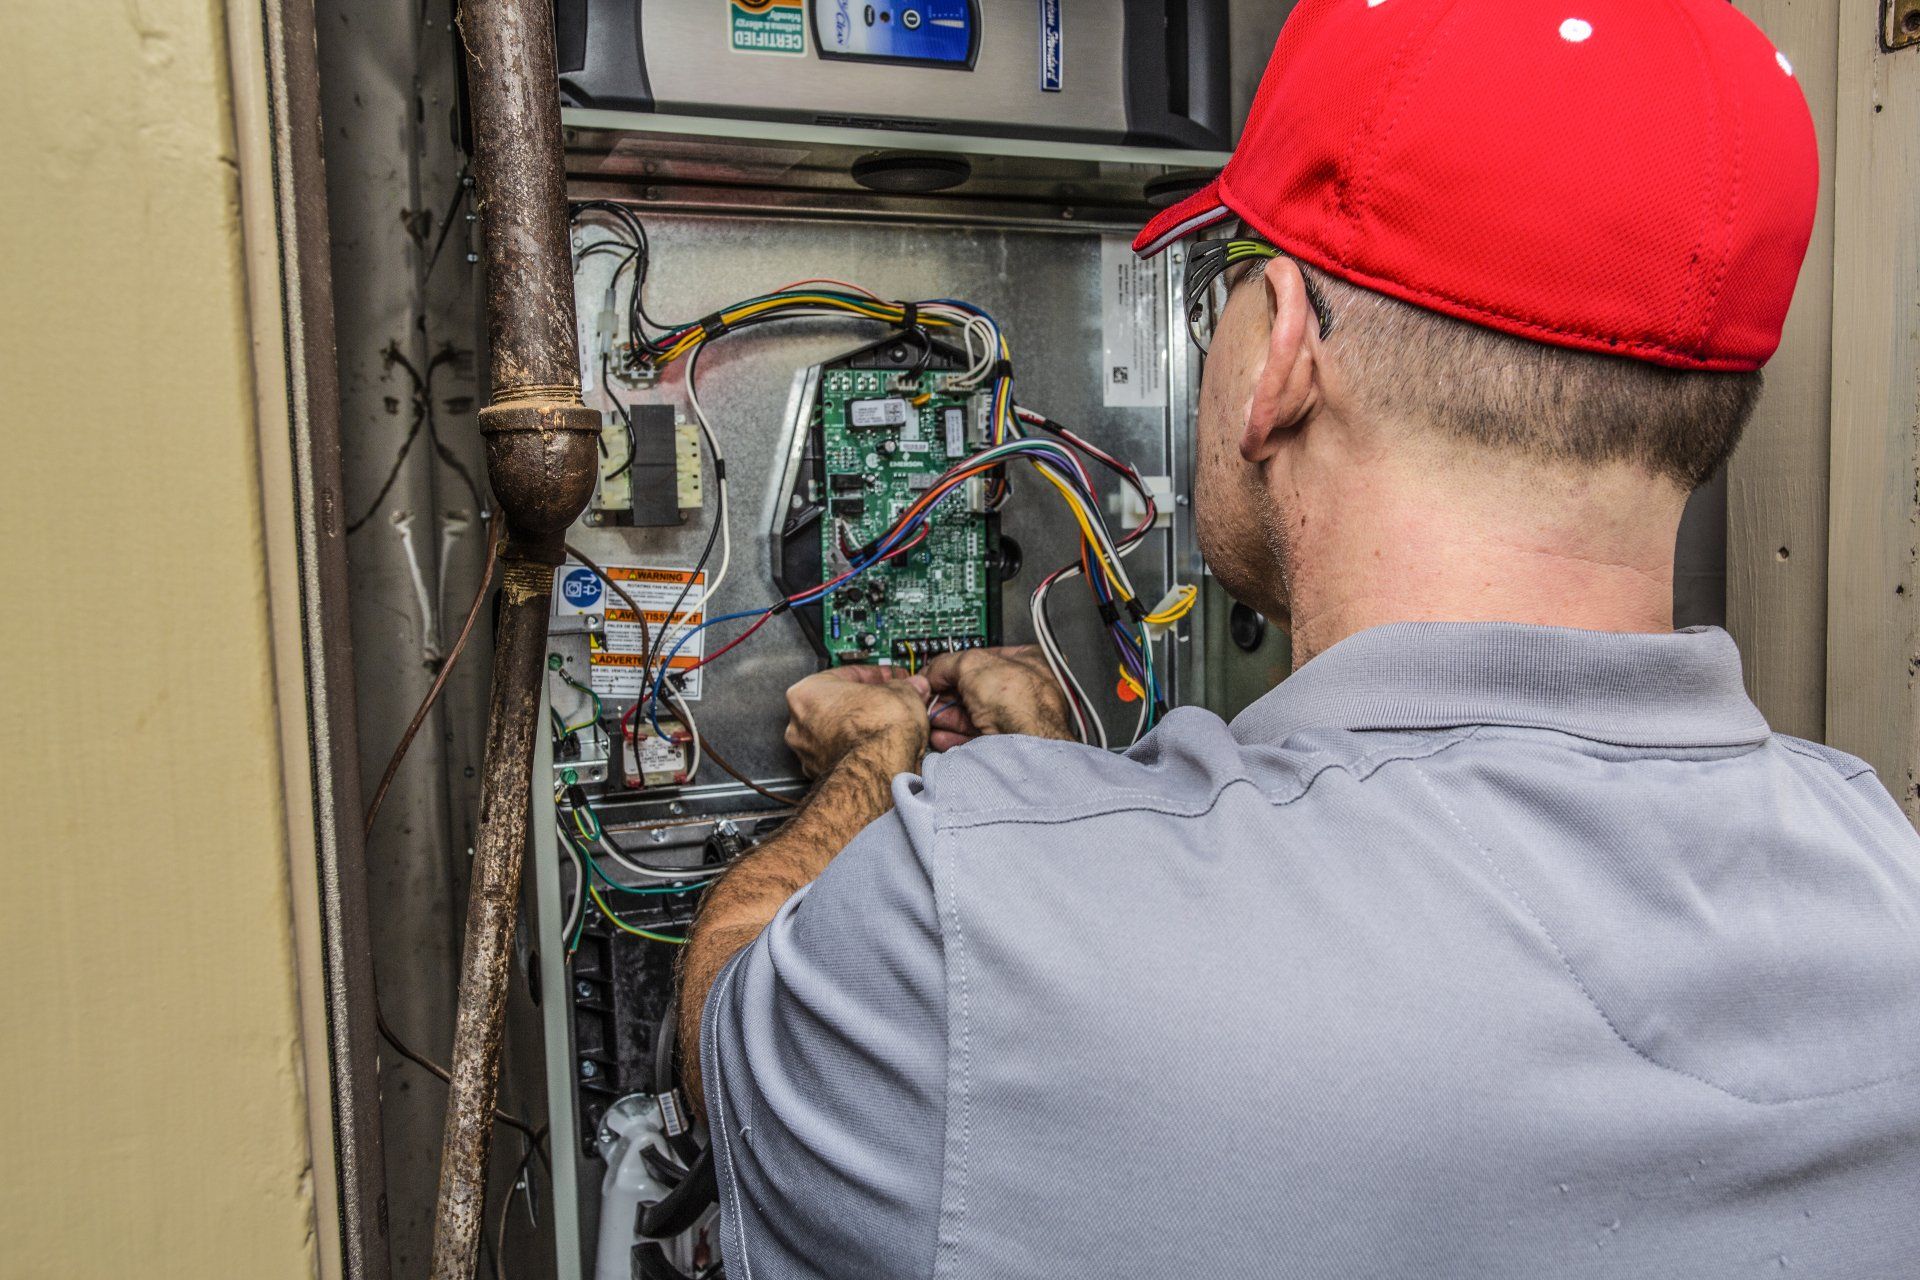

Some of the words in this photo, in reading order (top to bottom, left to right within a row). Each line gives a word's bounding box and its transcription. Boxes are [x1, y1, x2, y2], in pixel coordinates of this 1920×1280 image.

[769, 10, 801, 22] friendly
[735, 18, 763, 30] allergy
[770, 22, 801, 32] asthma
[735, 31, 802, 49] CERTIFIED
[1046, 27, 1058, 83] Standard
[637, 571, 683, 582] WARNING
